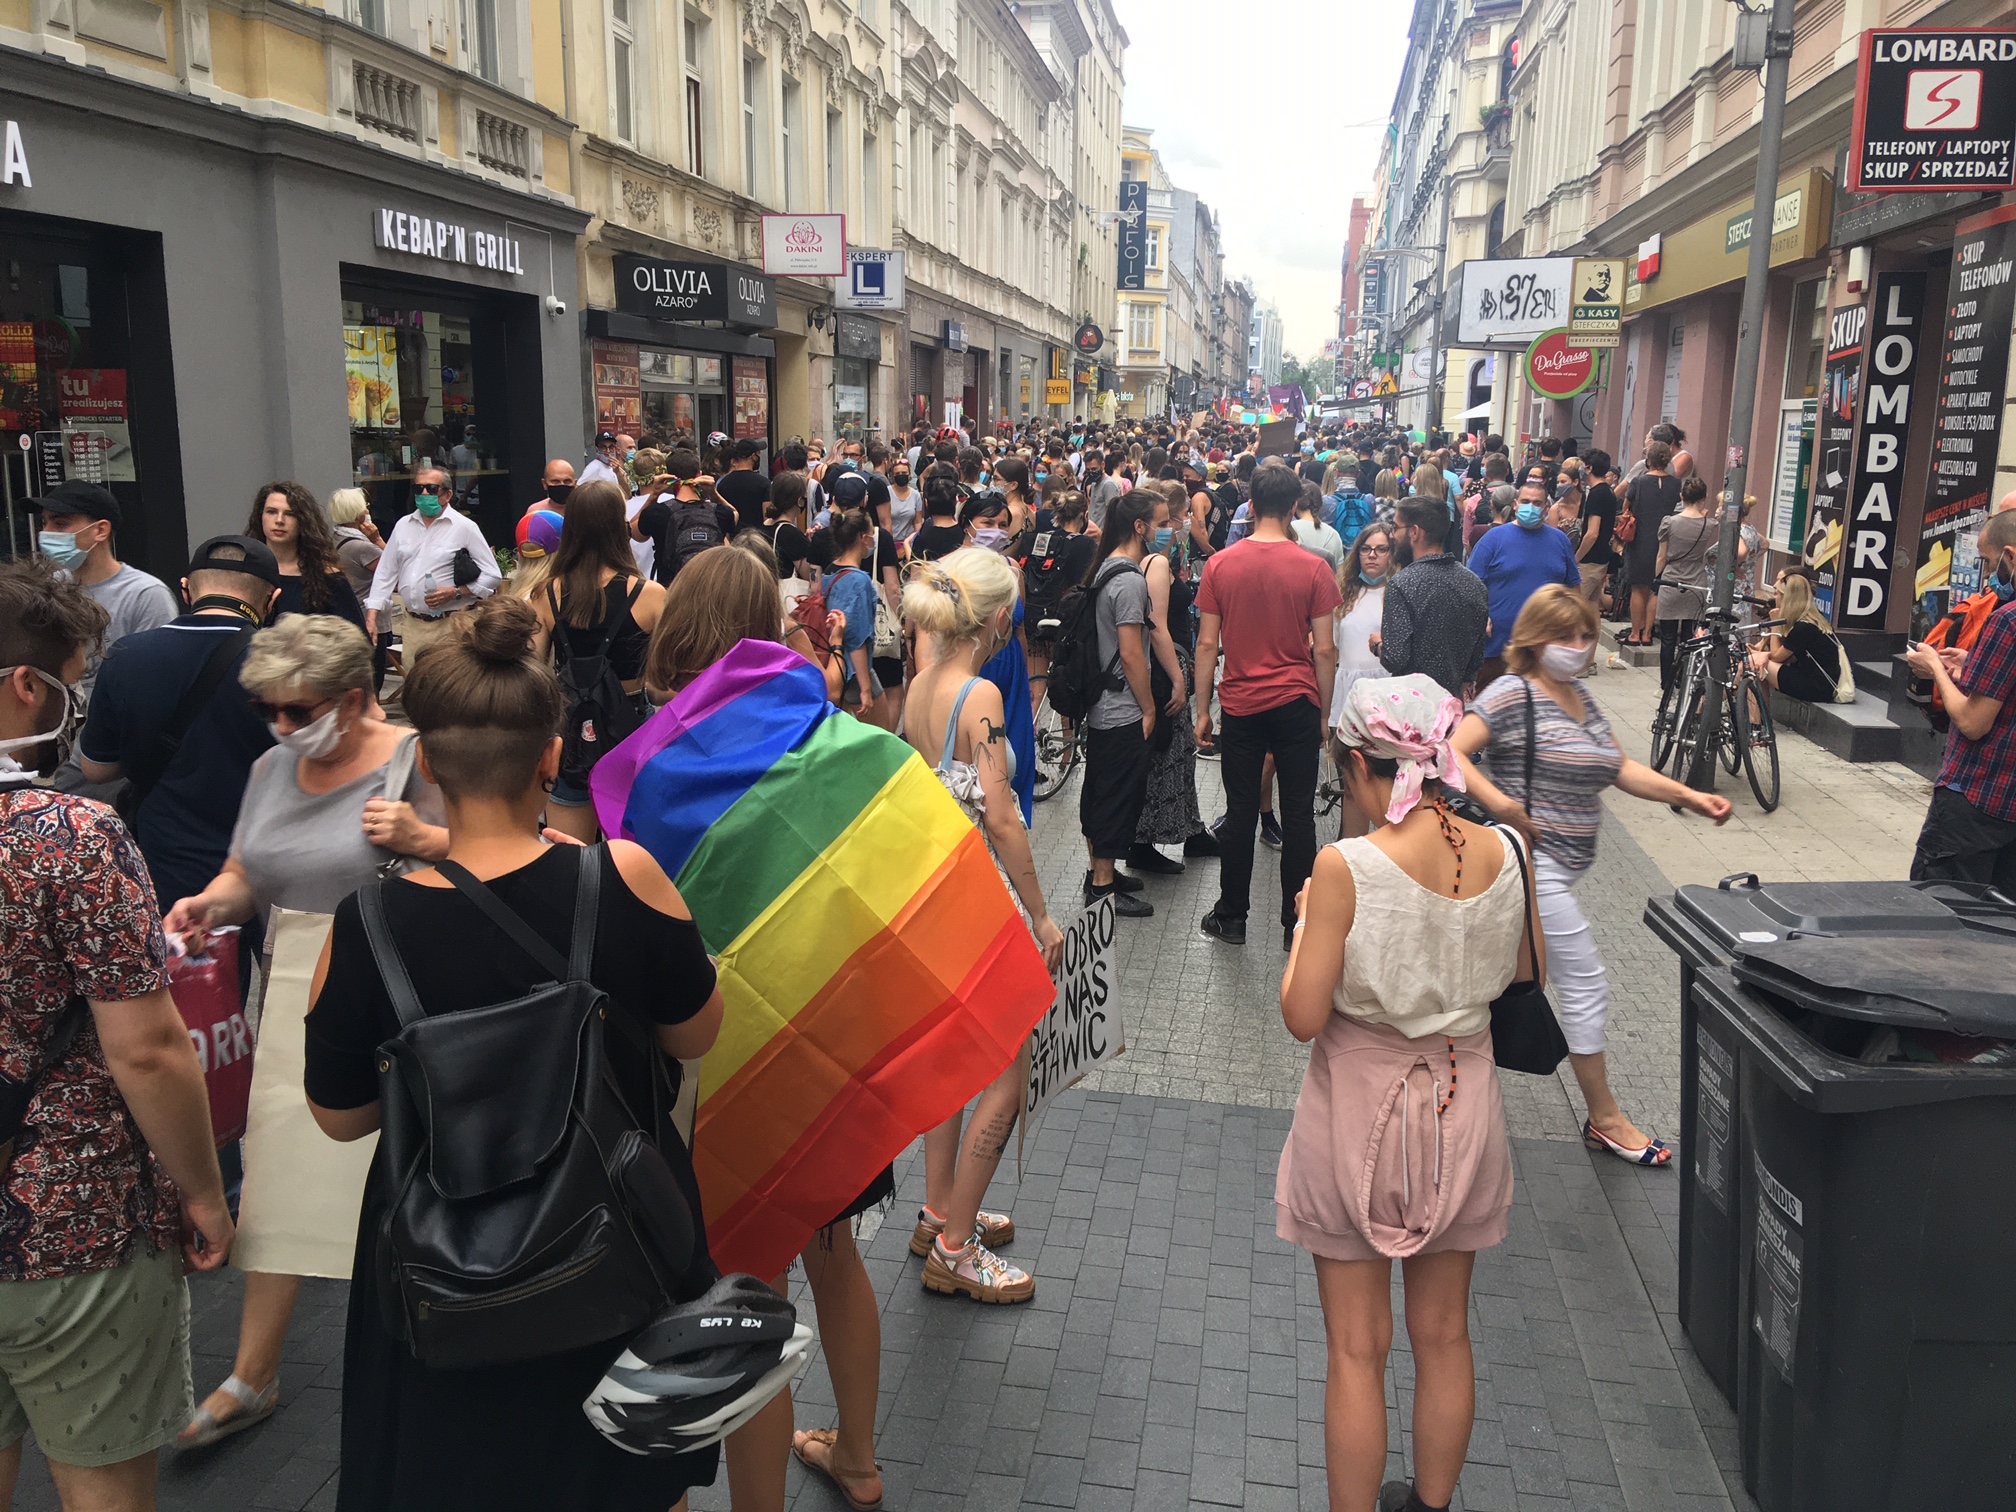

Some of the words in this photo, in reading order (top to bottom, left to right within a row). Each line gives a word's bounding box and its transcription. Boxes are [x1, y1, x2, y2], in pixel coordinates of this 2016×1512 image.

[1874, 38, 2016, 63] LOMBARD
[1868, 141, 1937, 156] TELEFONY
[1946, 140, 2010, 155] LAPTOPY
[1865, 161, 1909, 179] SKUP
[1921, 157, 2010, 178] SPRZEDAŻ
[1123, 183, 1140, 288] PARFOIS
[475, 230, 524, 276] GRILL
[786, 245, 823, 253] DAKINI
[846, 252, 893, 261] EKSPERT
[1961, 240, 1985, 266] SKUP
[633, 266, 712, 295] OLIVIA
[1960, 257, 2013, 292] TELEFONÓW
[738, 277, 766, 304] OLIVIA
[655, 295, 694, 309] AZARO
[746, 305, 761, 317] AZARO
[1956, 300, 1977, 319] ZŁOTO
[1588, 309, 1618, 318] KASY
[1574, 321, 1617, 329] STEFCZYKA
[1829, 305, 1867, 352] SKUP
[1953, 322, 1982, 341] LAPTOPY
[1951, 345, 1984, 364] SAMOCHODY
[61, 375, 90, 396] tu
[1949, 369, 1979, 387] MOTOCYKLE
[1047, 386, 1069, 394] EYFEL
[63, 398, 123, 410] zrealizujesz
[1830, 427, 1852, 441] TELEFONY
[1846, 285, 1914, 616] LOMBARD
[1964, 461, 1978, 477] GSM
[1814, 493, 1834, 508] LAPTOPY
[1818, 571, 1834, 587] ZŁOTO
[1060, 897, 1115, 982] OBRO
[1064, 960, 1109, 1028] NAS
